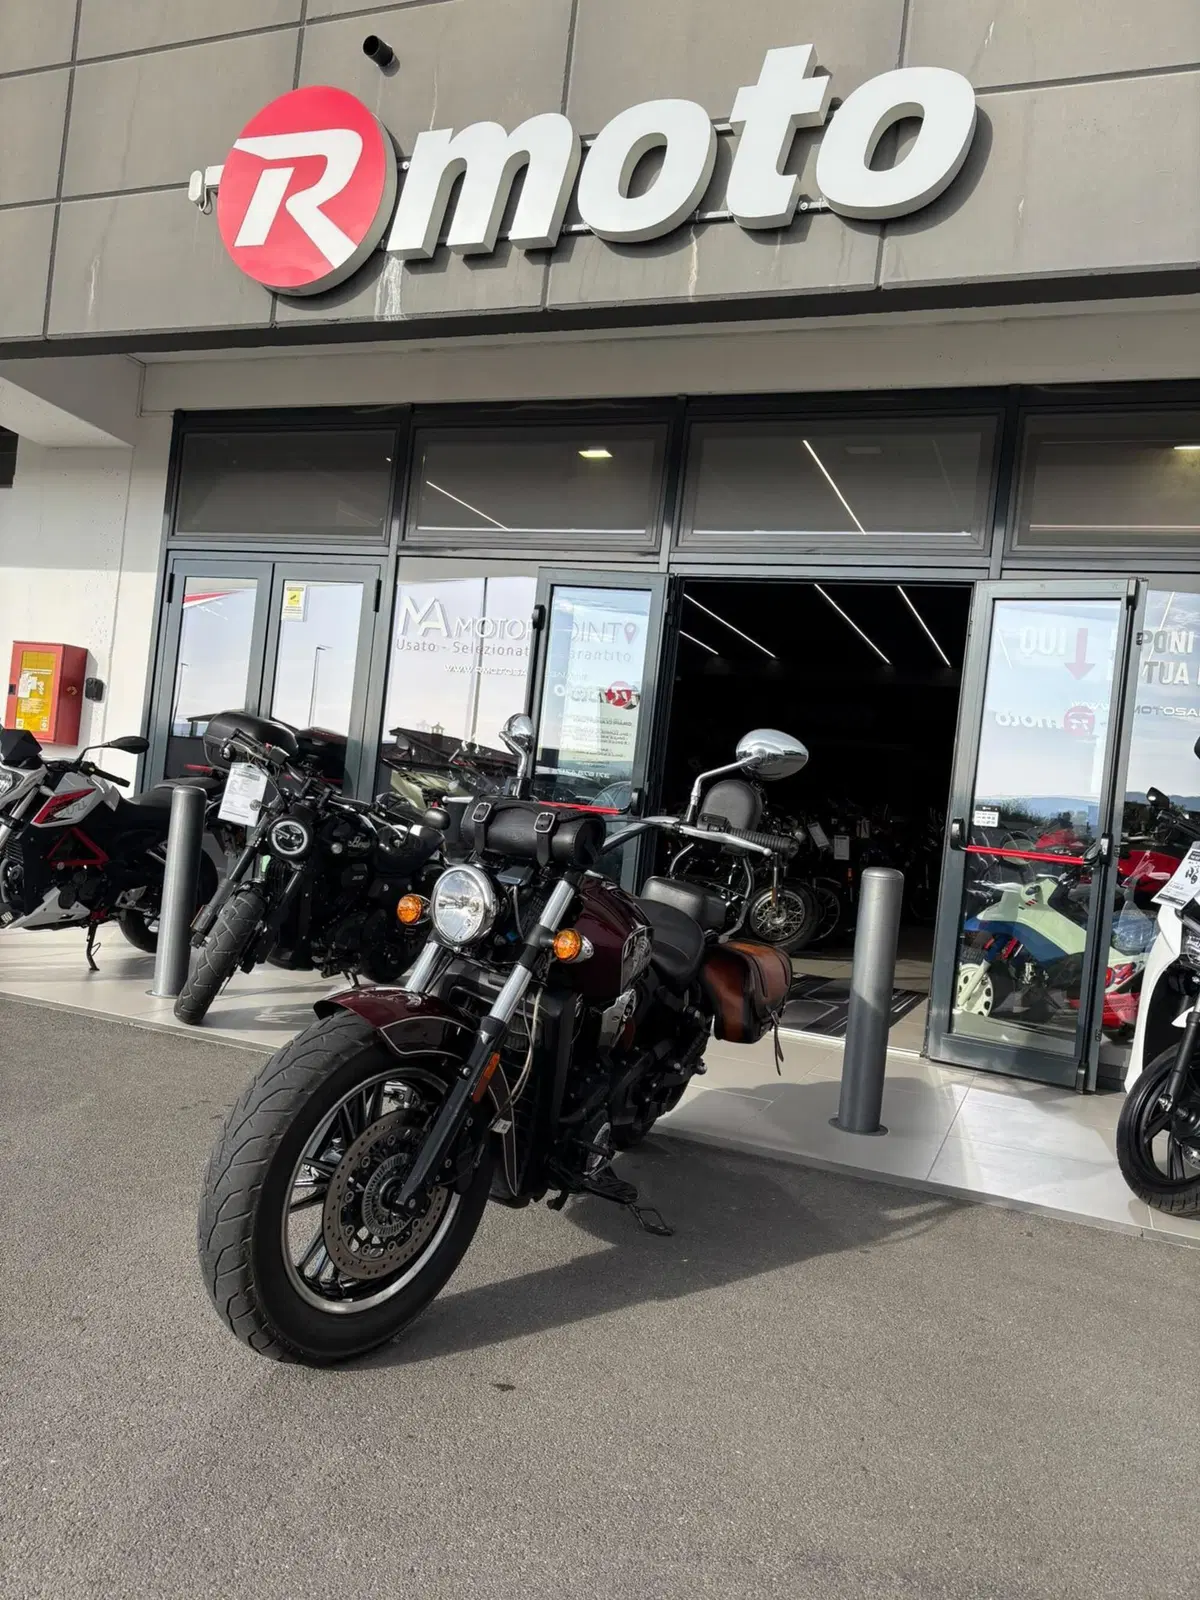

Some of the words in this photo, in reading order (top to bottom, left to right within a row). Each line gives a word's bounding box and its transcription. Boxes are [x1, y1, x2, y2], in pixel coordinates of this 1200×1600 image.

[396, 638, 436, 652] Usato
[453, 641, 531, 657] Selezionat
[1143, 661, 1190, 685] TUA
